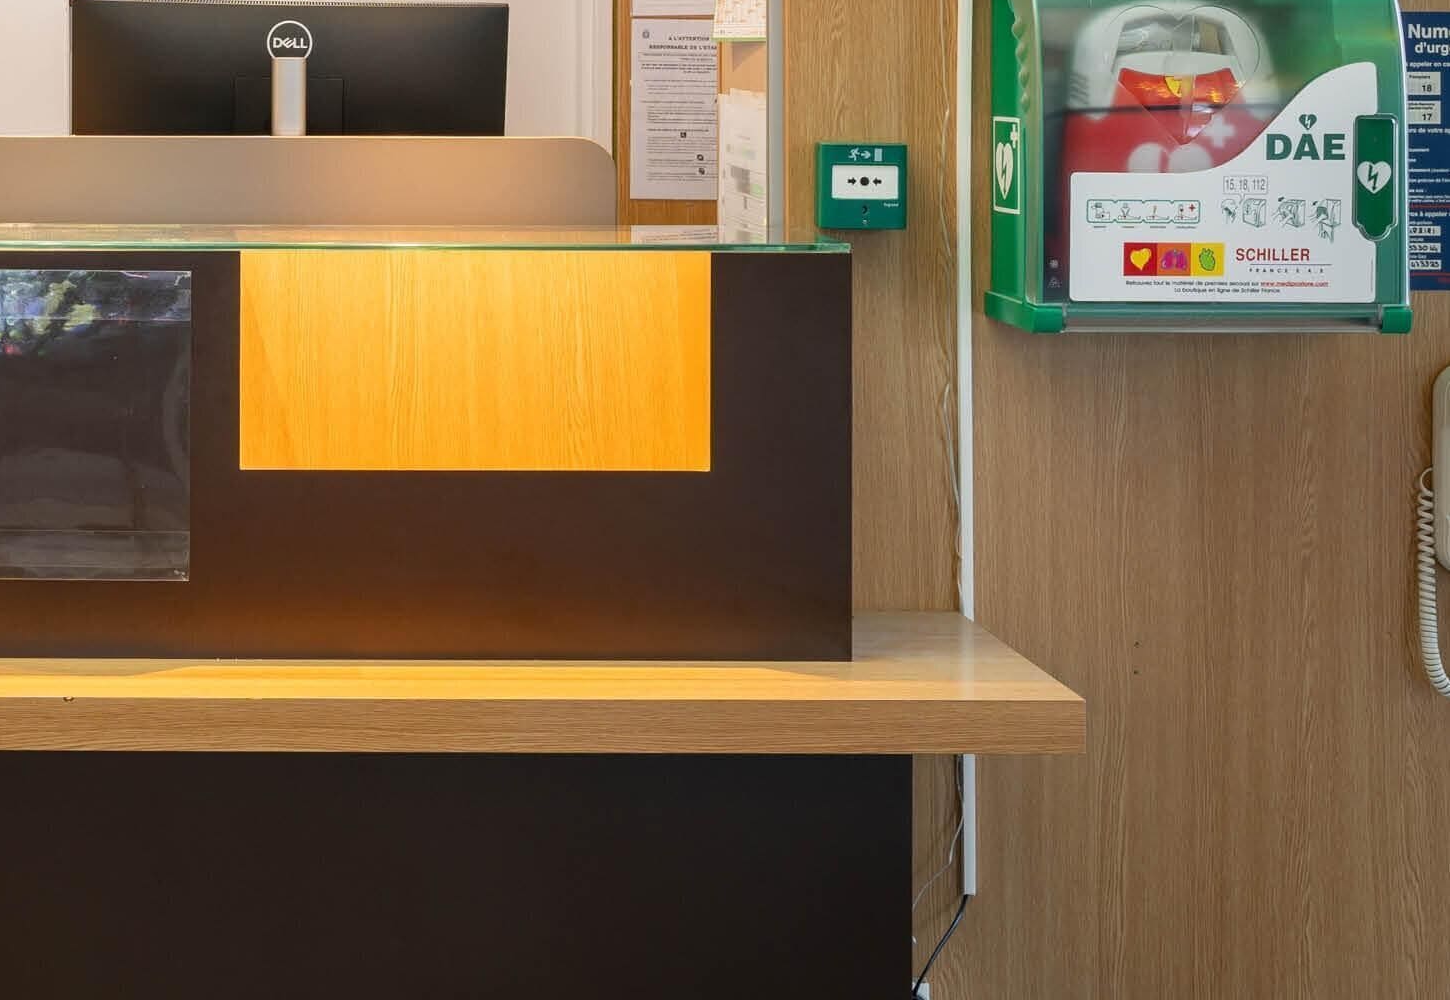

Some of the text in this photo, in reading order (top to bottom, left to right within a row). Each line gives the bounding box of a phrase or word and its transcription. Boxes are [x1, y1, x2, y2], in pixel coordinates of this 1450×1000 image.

[1408, 23, 1450, 39] Num
[272, 37, 308, 49] DELL
[1415, 41, 1450, 56] d'urg
[1421, 84, 1432, 92] 18
[1421, 113, 1432, 121] 17
[1265, 133, 1346, 161] DAE
[1252, 179, 1266, 191] 112
[1235, 248, 1311, 262] SCHILLER
